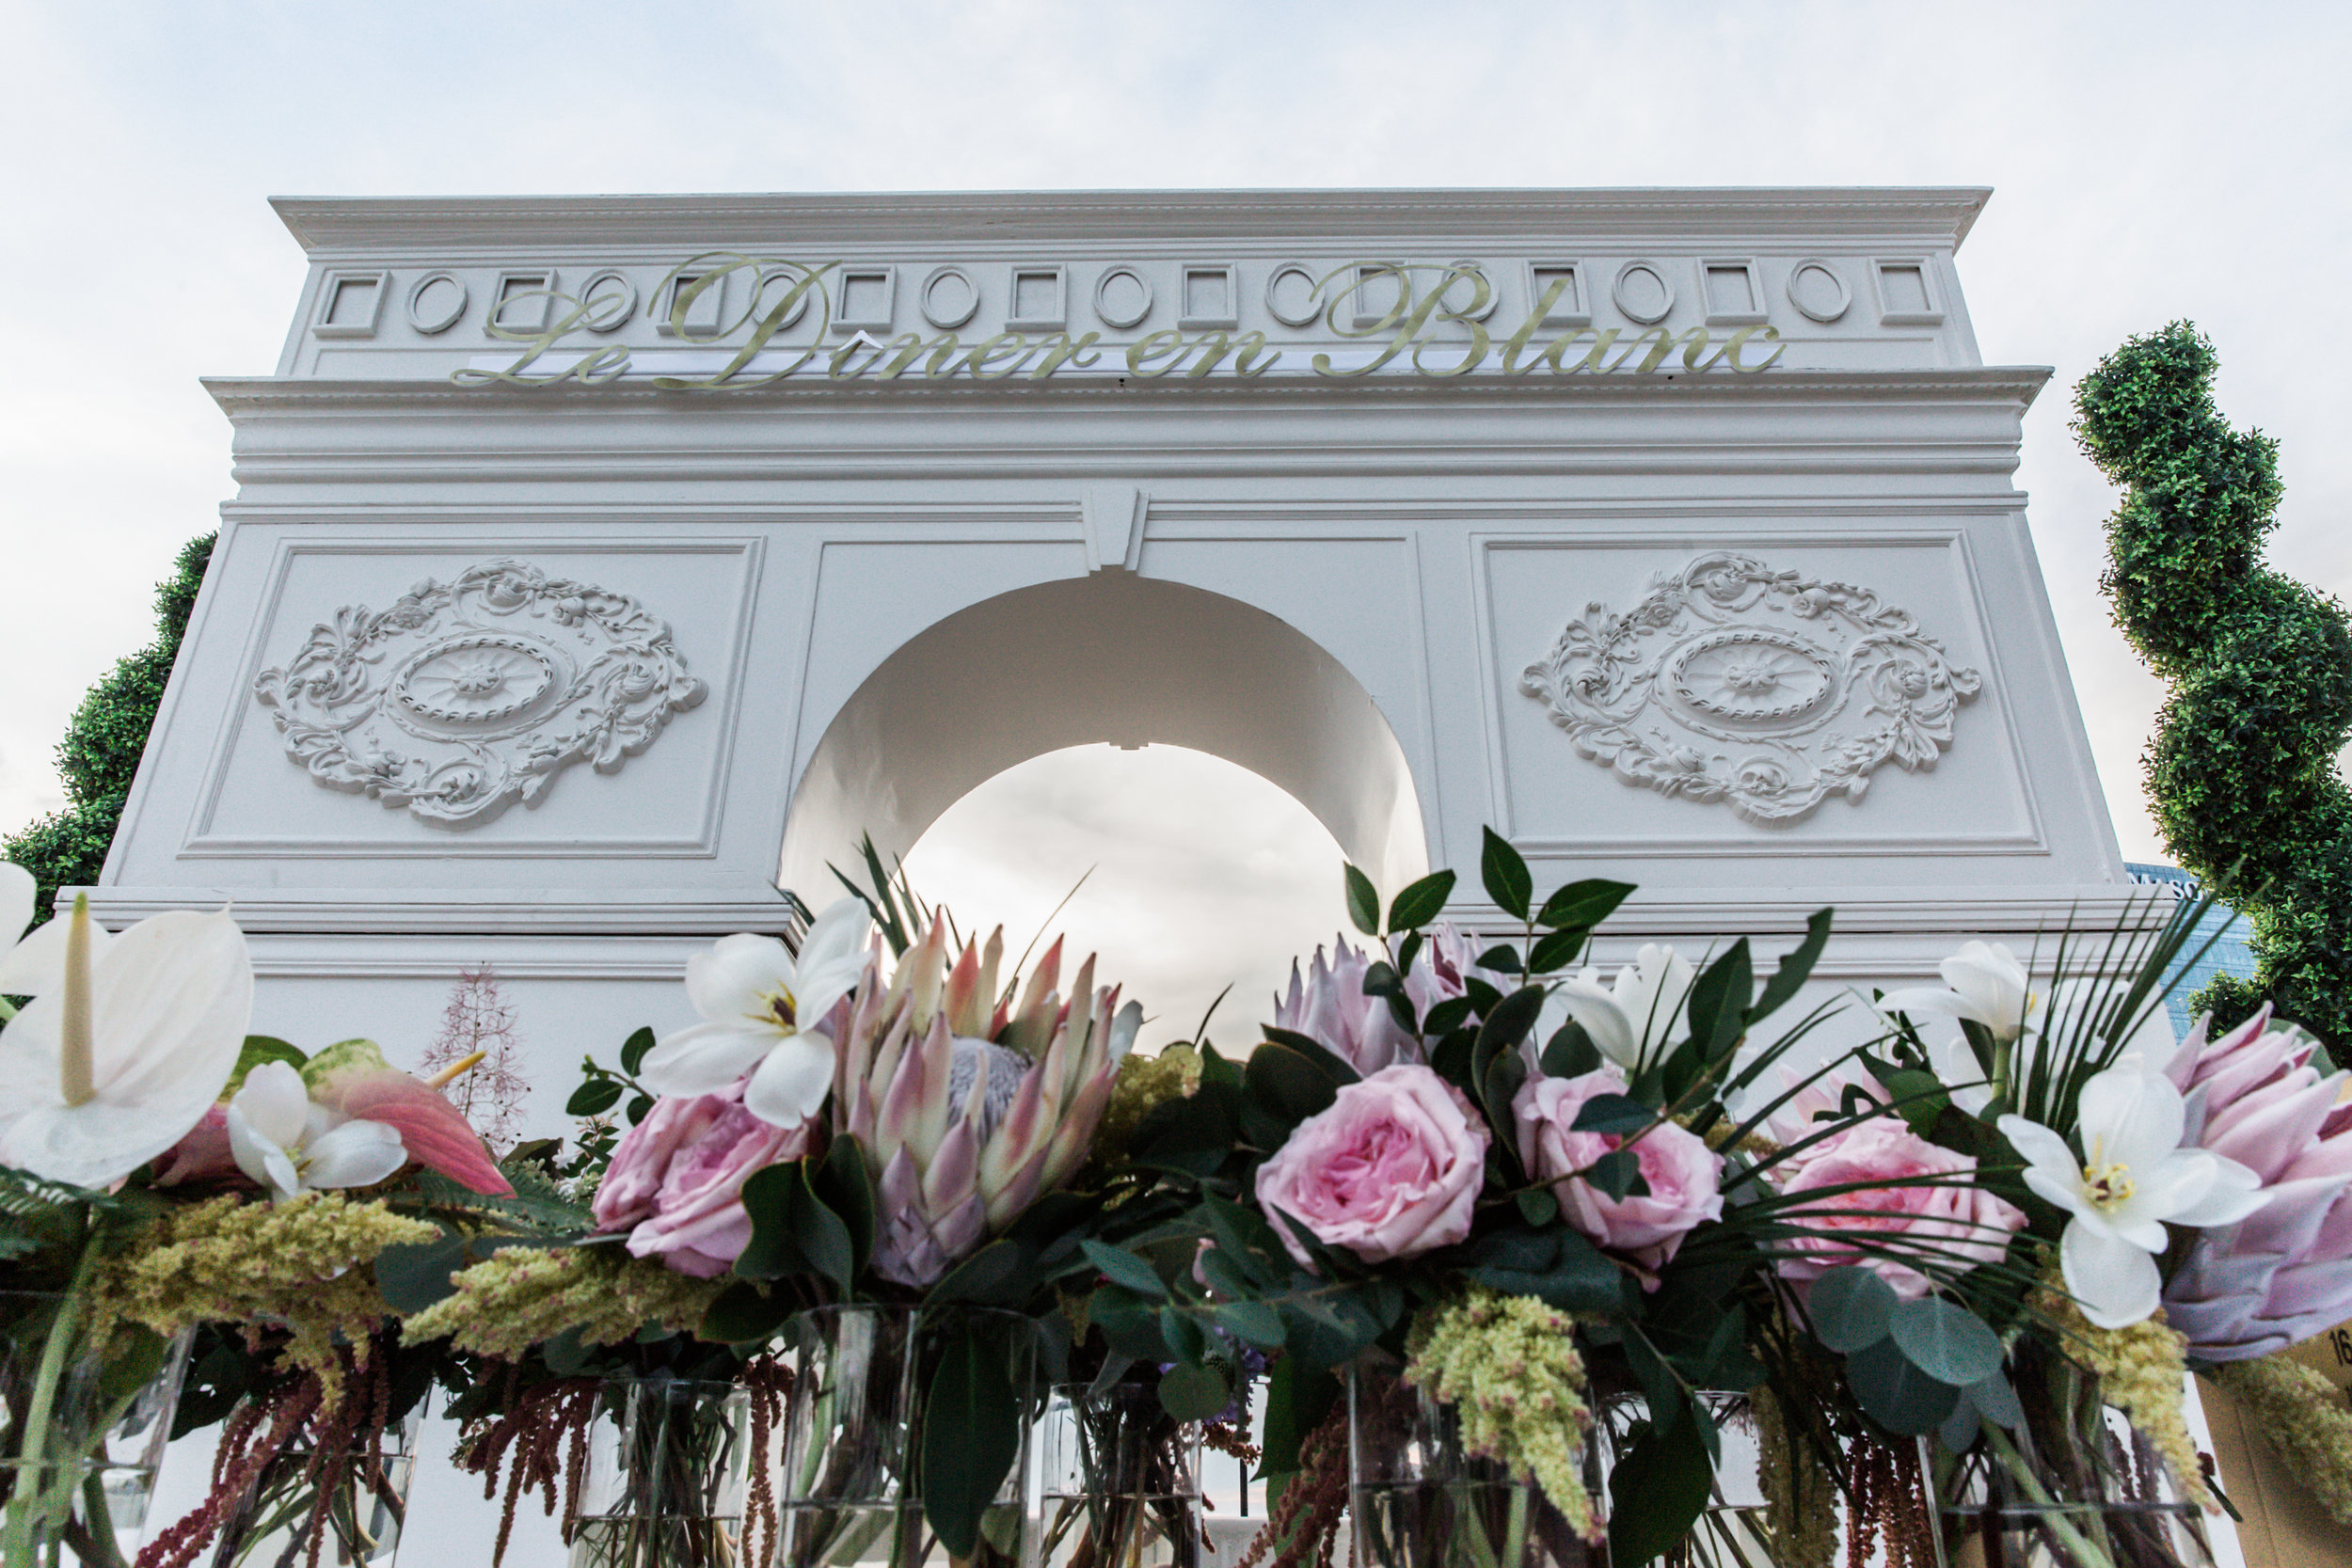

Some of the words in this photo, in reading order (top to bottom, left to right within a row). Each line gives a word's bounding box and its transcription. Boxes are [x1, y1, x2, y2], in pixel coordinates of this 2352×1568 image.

[449, 290, 632, 387] Le
[1125, 329, 1282, 378] en
[1309, 260, 1787, 378] Blanc
